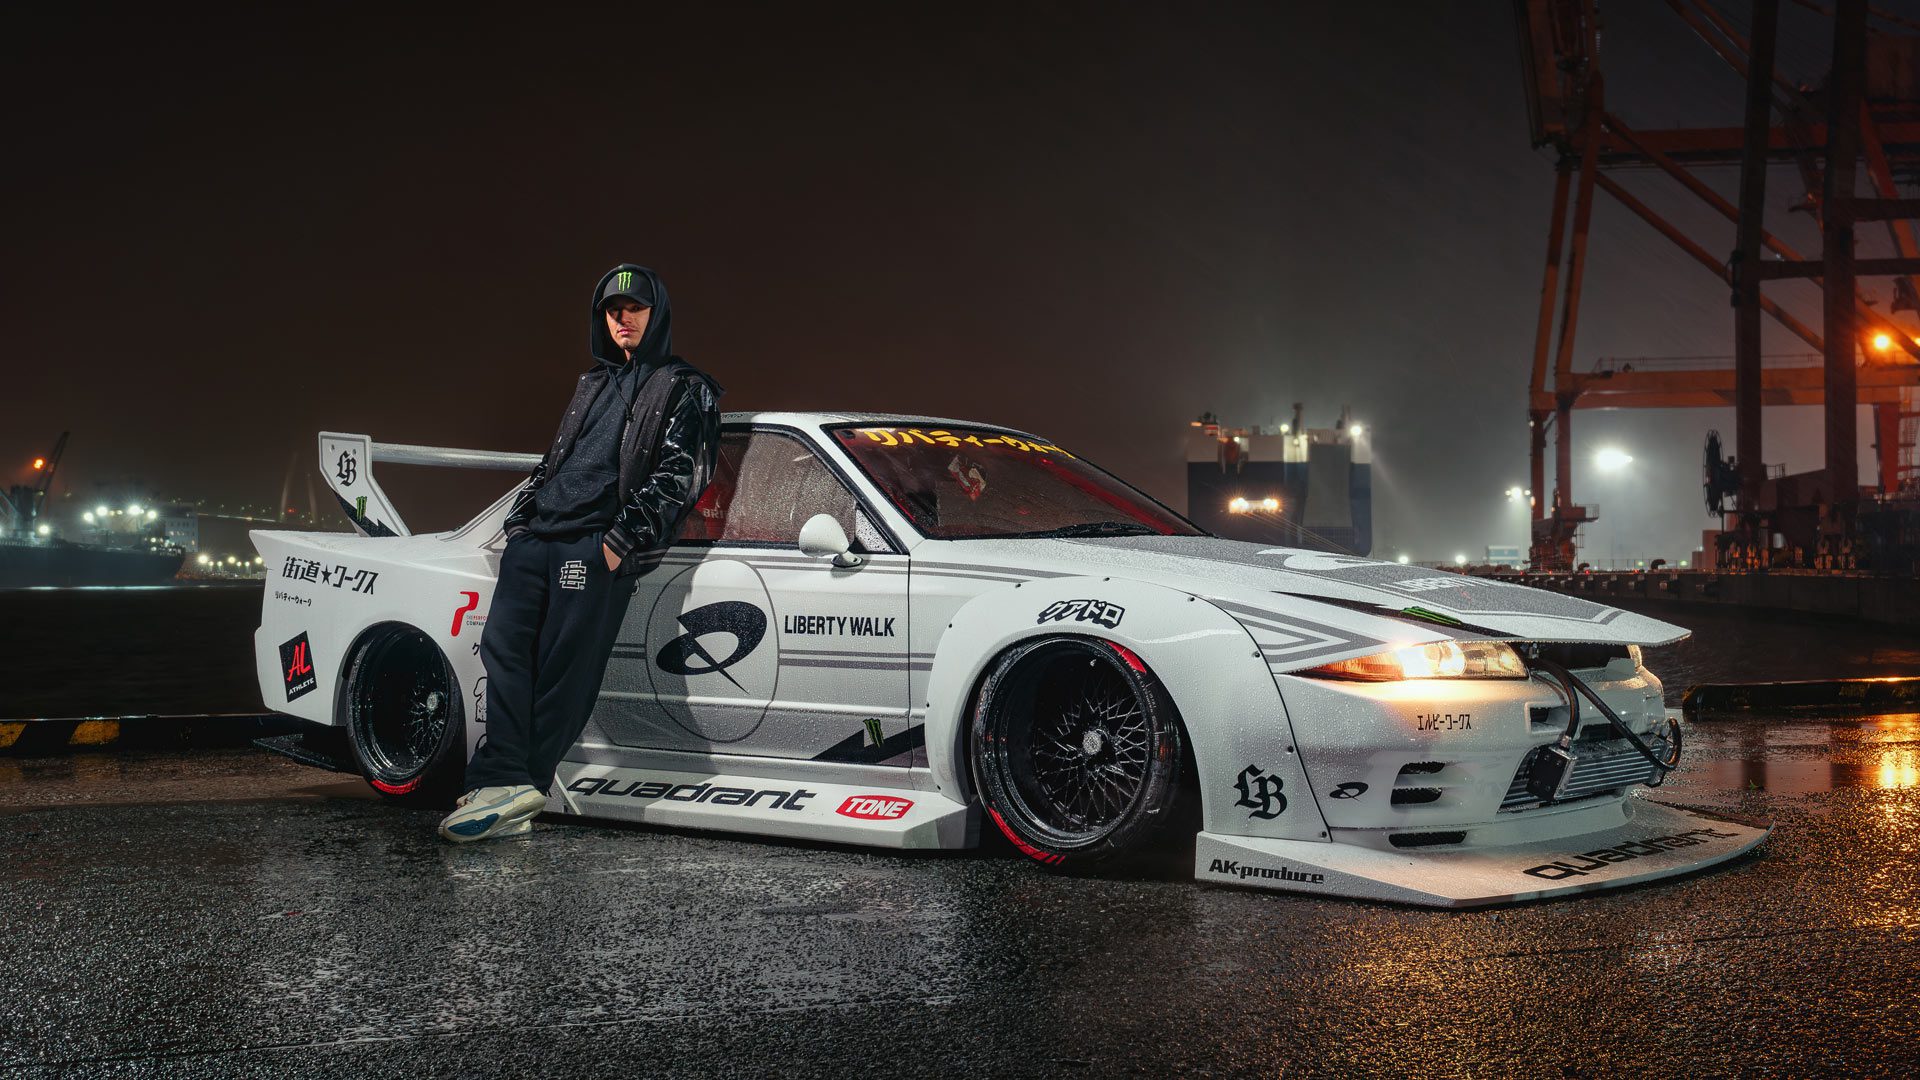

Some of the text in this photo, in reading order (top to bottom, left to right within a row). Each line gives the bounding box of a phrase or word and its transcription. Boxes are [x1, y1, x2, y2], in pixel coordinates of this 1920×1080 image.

[784, 615, 896, 637] LIBERTY WALK
[287, 641, 312, 682] AL
[288, 677, 316, 695] ATHLETE
[566, 776, 818, 811] quadrant
[844, 796, 910, 819] TONE
[1208, 858, 1325, 885] AK-produce
